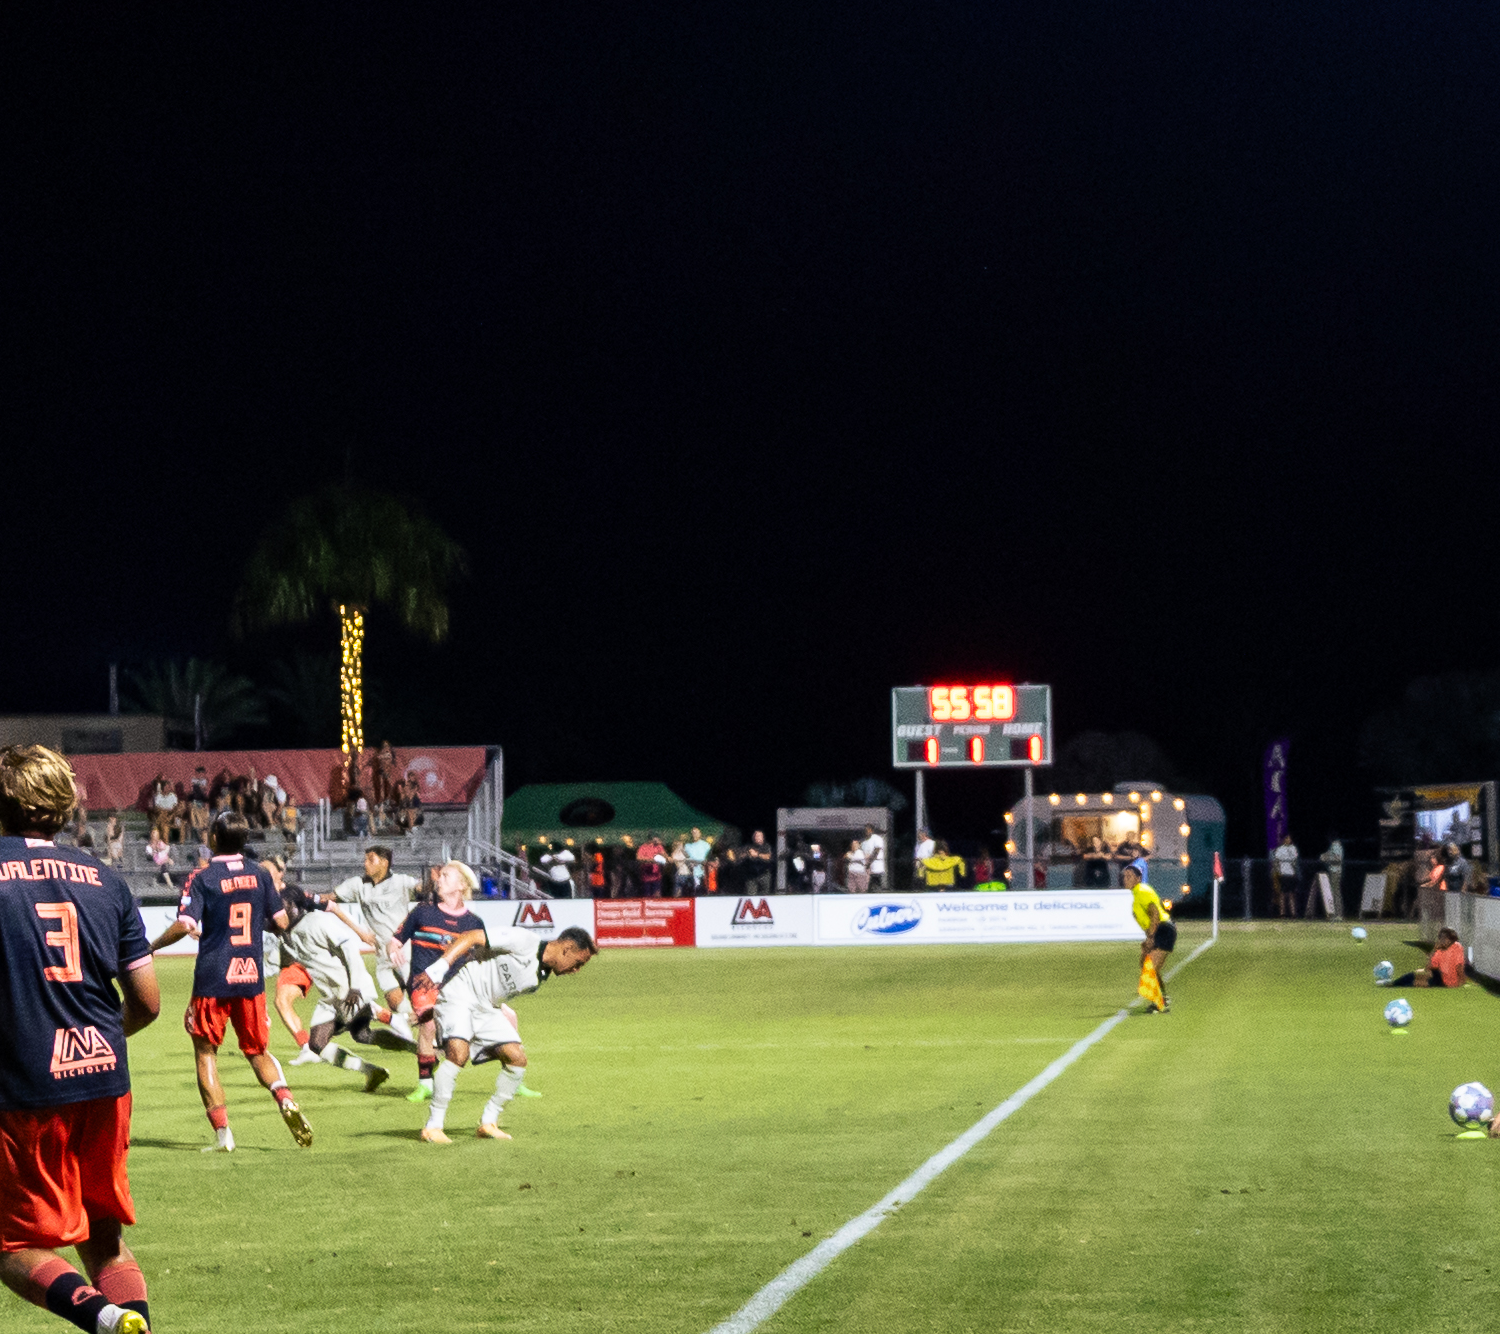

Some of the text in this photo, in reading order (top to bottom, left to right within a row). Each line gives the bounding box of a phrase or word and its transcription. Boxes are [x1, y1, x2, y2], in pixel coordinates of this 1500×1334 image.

[897, 724, 942, 737] GUEST
[1002, 722, 1043, 734] HOME
[926, 734, 1042, 764] 1 1 1
[936, 902, 1008, 912] Welcome
[1014, 901, 1029, 911] to
[229, 903, 252, 946] 9
[35, 901, 83, 982] 3
[53, 1062, 116, 1079] NICHOLAS
